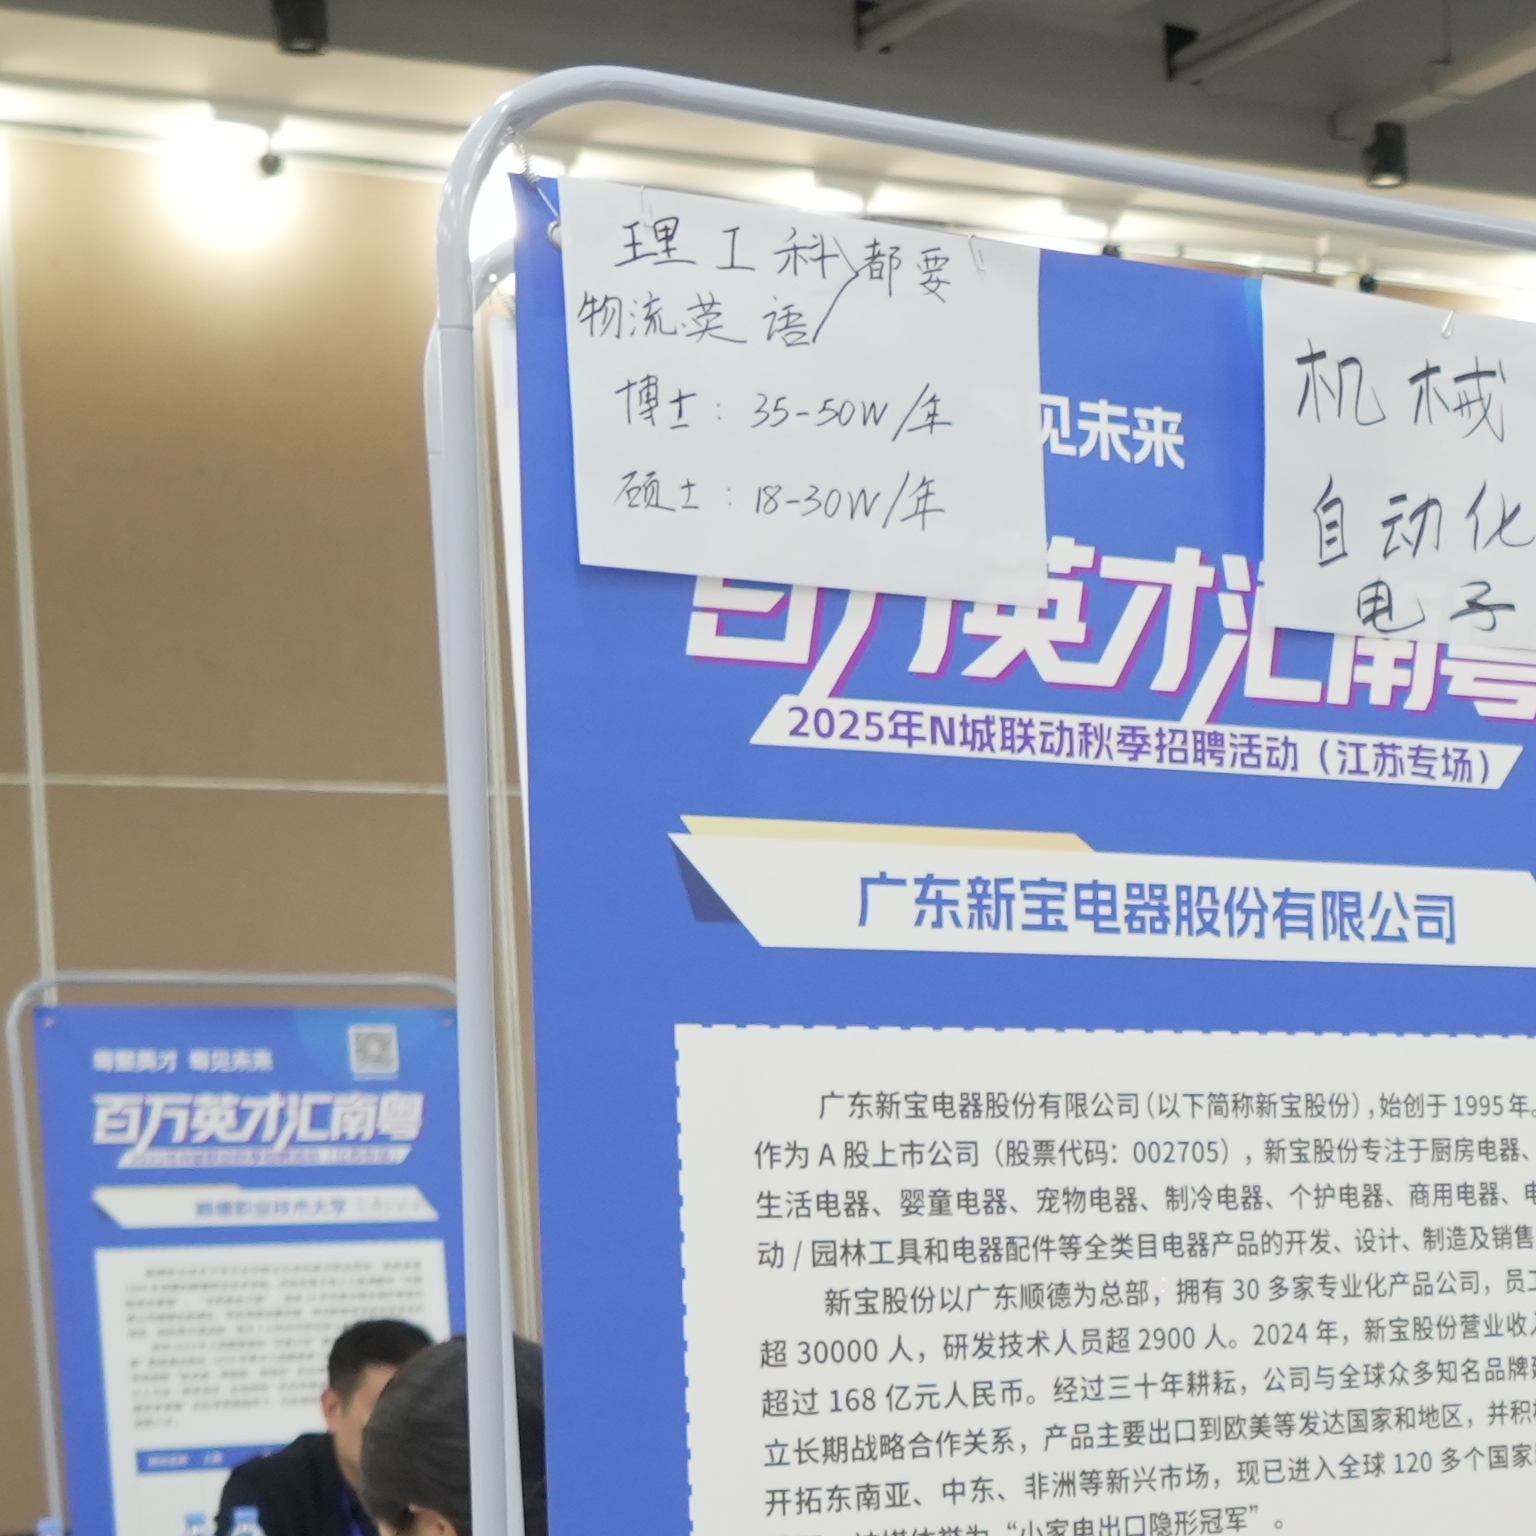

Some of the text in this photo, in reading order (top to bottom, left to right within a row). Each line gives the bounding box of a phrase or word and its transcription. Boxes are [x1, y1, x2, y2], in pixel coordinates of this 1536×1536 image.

[614, 217, 951, 304] 理工科 都要
[1296, 338, 1506, 443] 机械
[1313, 474, 1536, 568] 自动化
[1357, 575, 1516, 634] 电子
[787, 704, 1492, 786] 2025年N城联动秋季招聘活动（江苏专场）
[858, 871, 1455, 944] 广东新宝电器股份有限公司
[93, 1091, 424, 1150] 百万英才汇南粤
[1454, 1095, 1503, 1116] 1995
[755, 1140, 808, 1169] 作为
[819, 1144, 835, 1166] A
[758, 1241, 784, 1268] 动
[793, 1241, 802, 1271] /
[825, 1278, 1224, 1316] 新宝股份以广东顺德为总部，拥有
[1233, 1278, 1259, 1301] 30
[761, 1340, 787, 1368] 超
[798, 1339, 877, 1364] 30000
[889, 1327, 1130, 1363] 人，研发技术人员超
[1139, 1327, 1195, 1350] 2900
[762, 1388, 819, 1418] 超过
[830, 1388, 876, 1412] 168
[765, 1452, 1385, 1516] 开拓东南亚、中东、非洲等新兴市场，现已进入全球
[1395, 1451, 1432, 1474] 120
